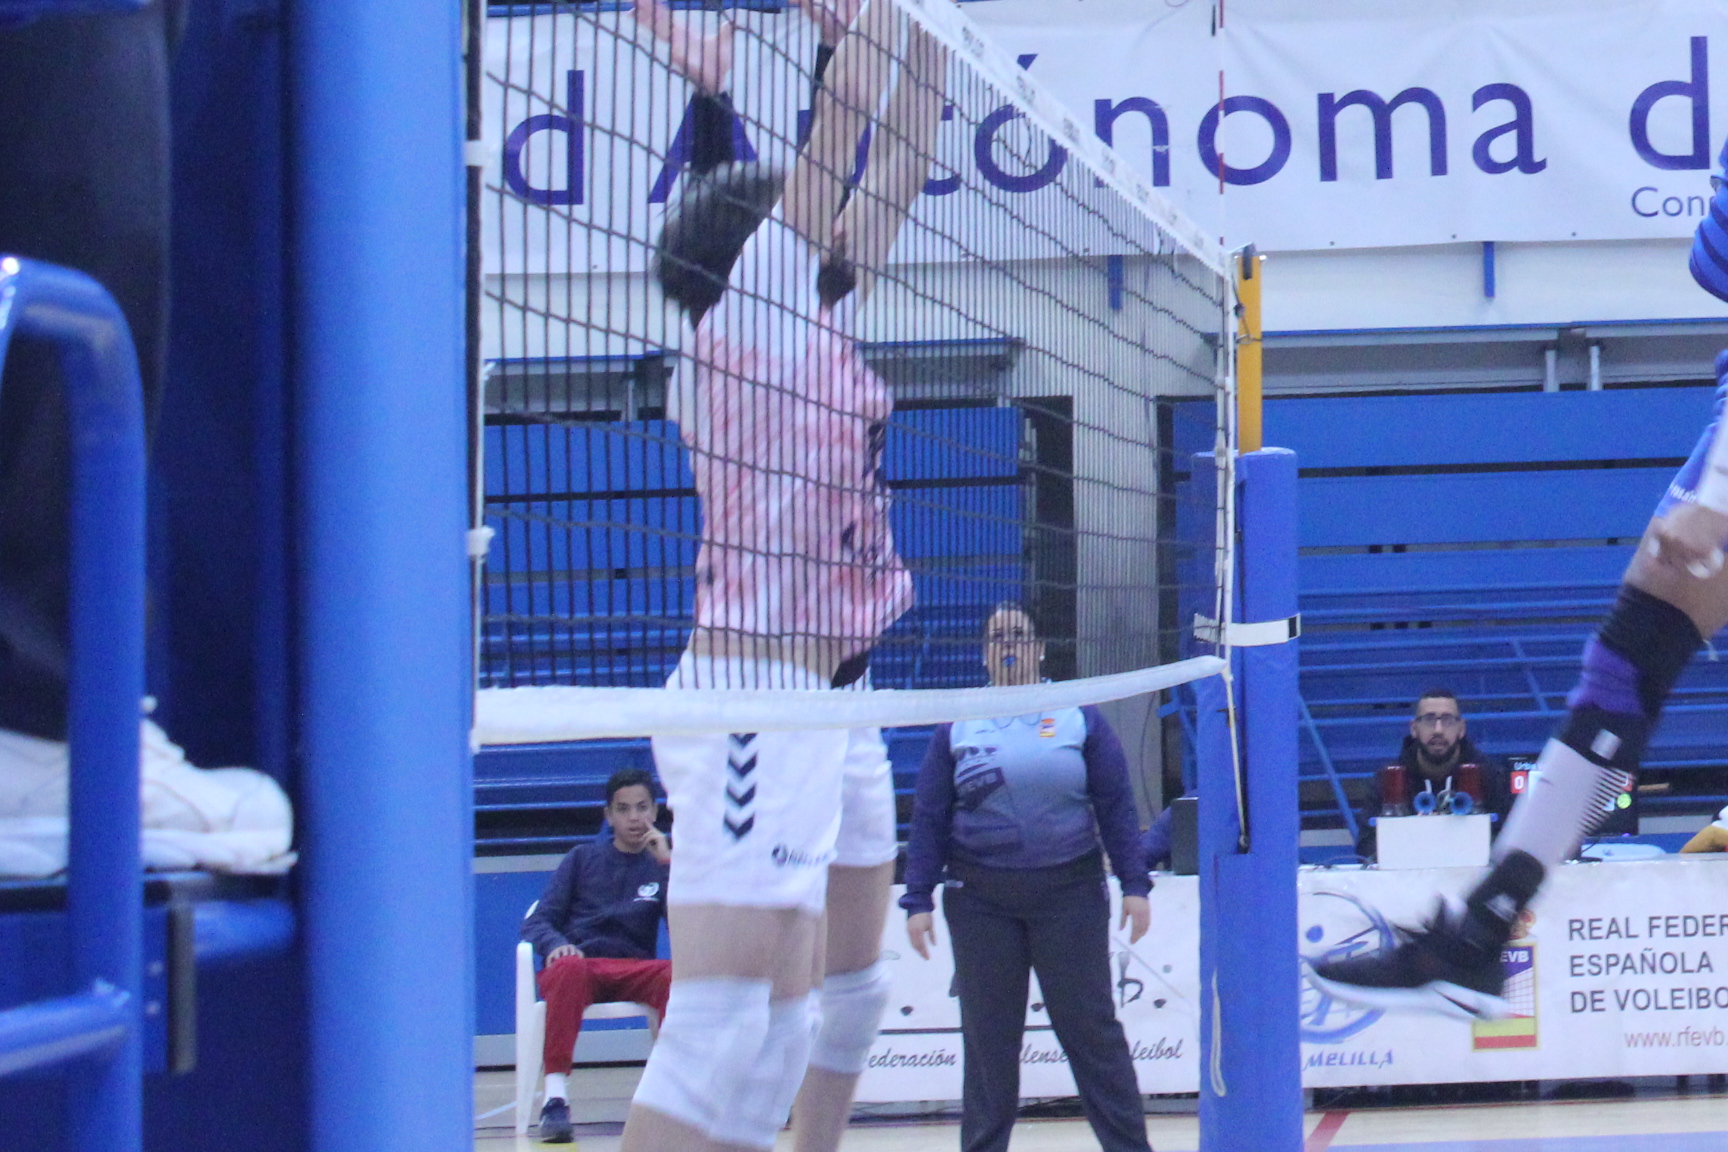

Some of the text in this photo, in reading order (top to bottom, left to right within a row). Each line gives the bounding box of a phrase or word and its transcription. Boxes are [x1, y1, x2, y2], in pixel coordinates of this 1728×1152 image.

[1568, 917, 1639, 940] REAL
[1500, 950, 1530, 963] EVB
[1570, 948, 1714, 977] ESPAÑOLA
[1571, 990, 1606, 1013] DE
[867, 1047, 957, 1069] ederación
[1130, 1036, 1184, 1062] leibol
